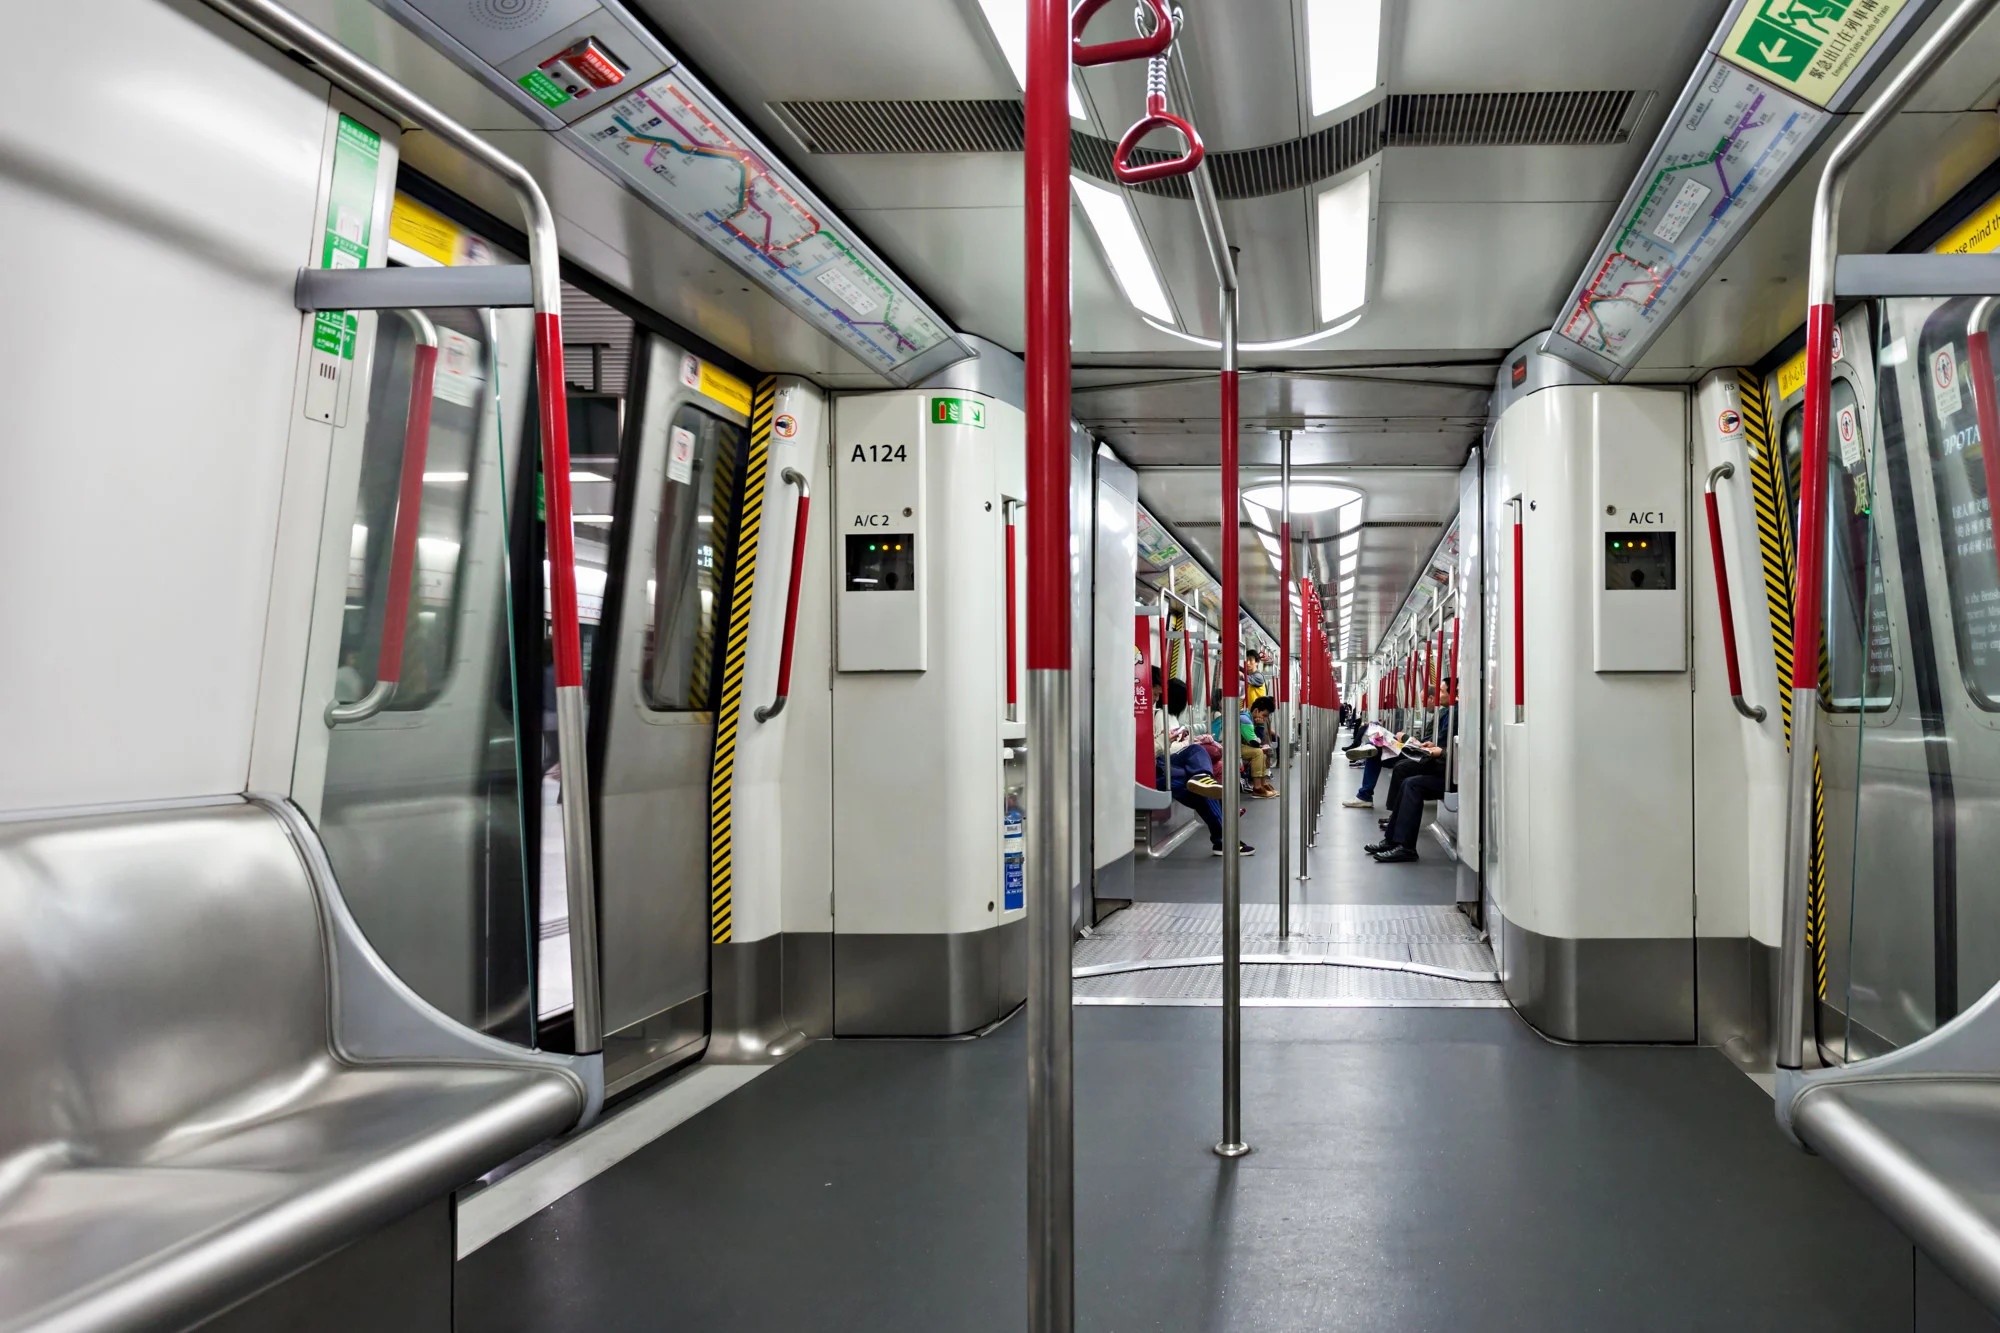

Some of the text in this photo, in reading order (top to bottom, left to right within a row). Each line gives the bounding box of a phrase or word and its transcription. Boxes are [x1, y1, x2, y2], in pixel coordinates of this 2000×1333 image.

[1831, 53, 1855, 77] Emergency
[1849, 40, 1863, 54] Exits
[1863, 23, 1876, 36] ends
[1877, 4, 1890, 19] train
[1969, 220, 1991, 248] mind
[851, 444, 907, 463] A124
[854, 514, 890, 527] A/C 2
[1629, 511, 1664, 524] A/C 1
